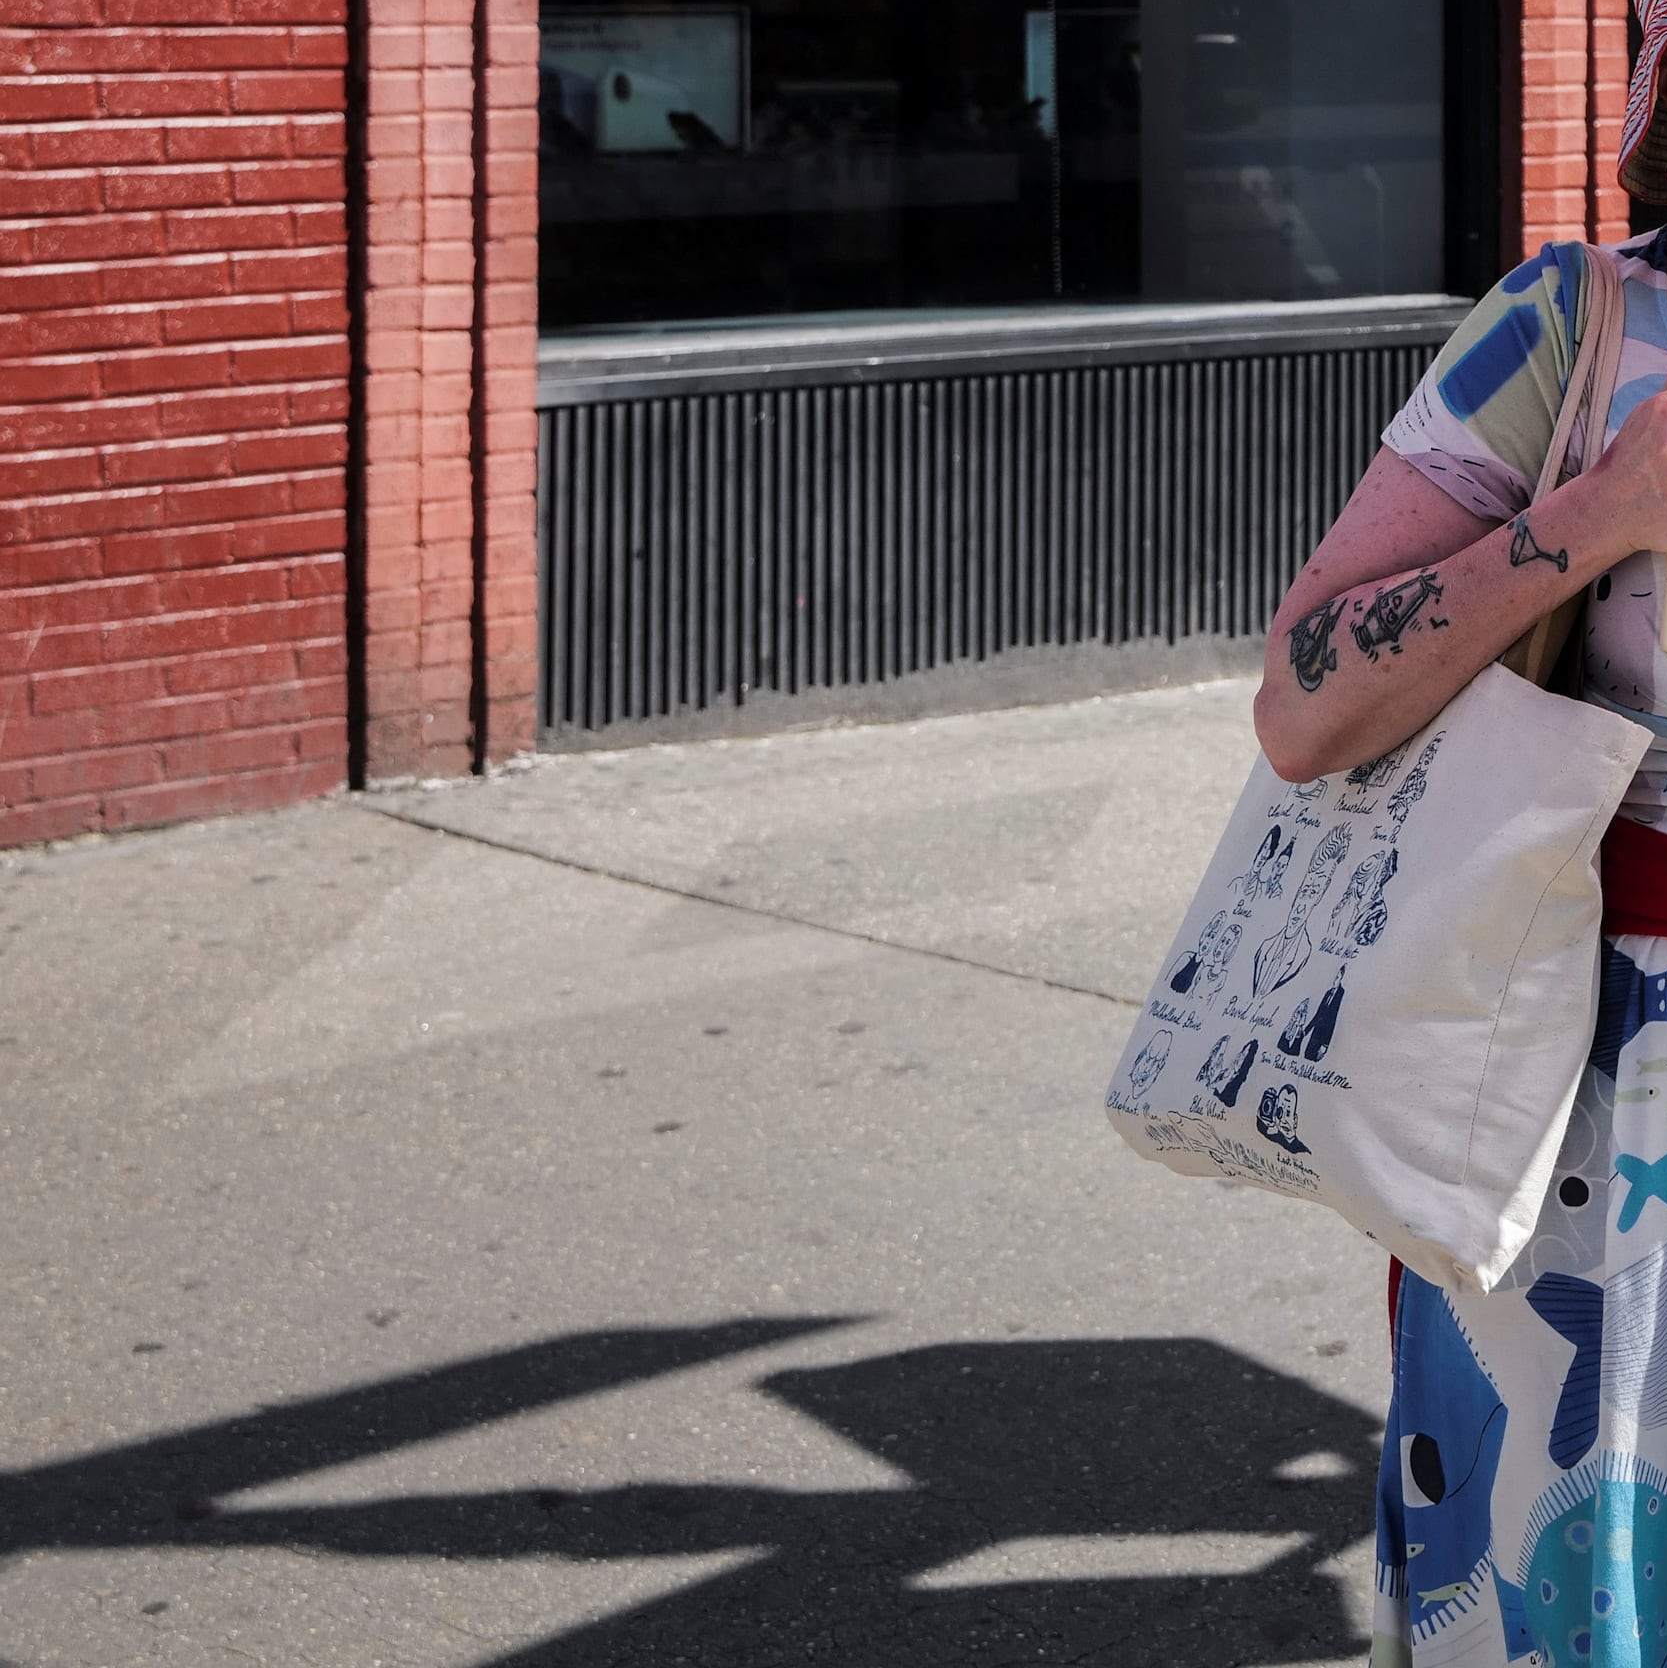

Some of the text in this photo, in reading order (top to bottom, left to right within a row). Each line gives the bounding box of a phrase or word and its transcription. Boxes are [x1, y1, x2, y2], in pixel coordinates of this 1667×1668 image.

[1232, 899, 1253, 918] Dune
[1222, 995, 1280, 1034] David Lynch
[1312, 1069, 1335, 1085] with
[1333, 1074, 1353, 1090] Me
[1190, 1095, 1204, 1116] Blue
